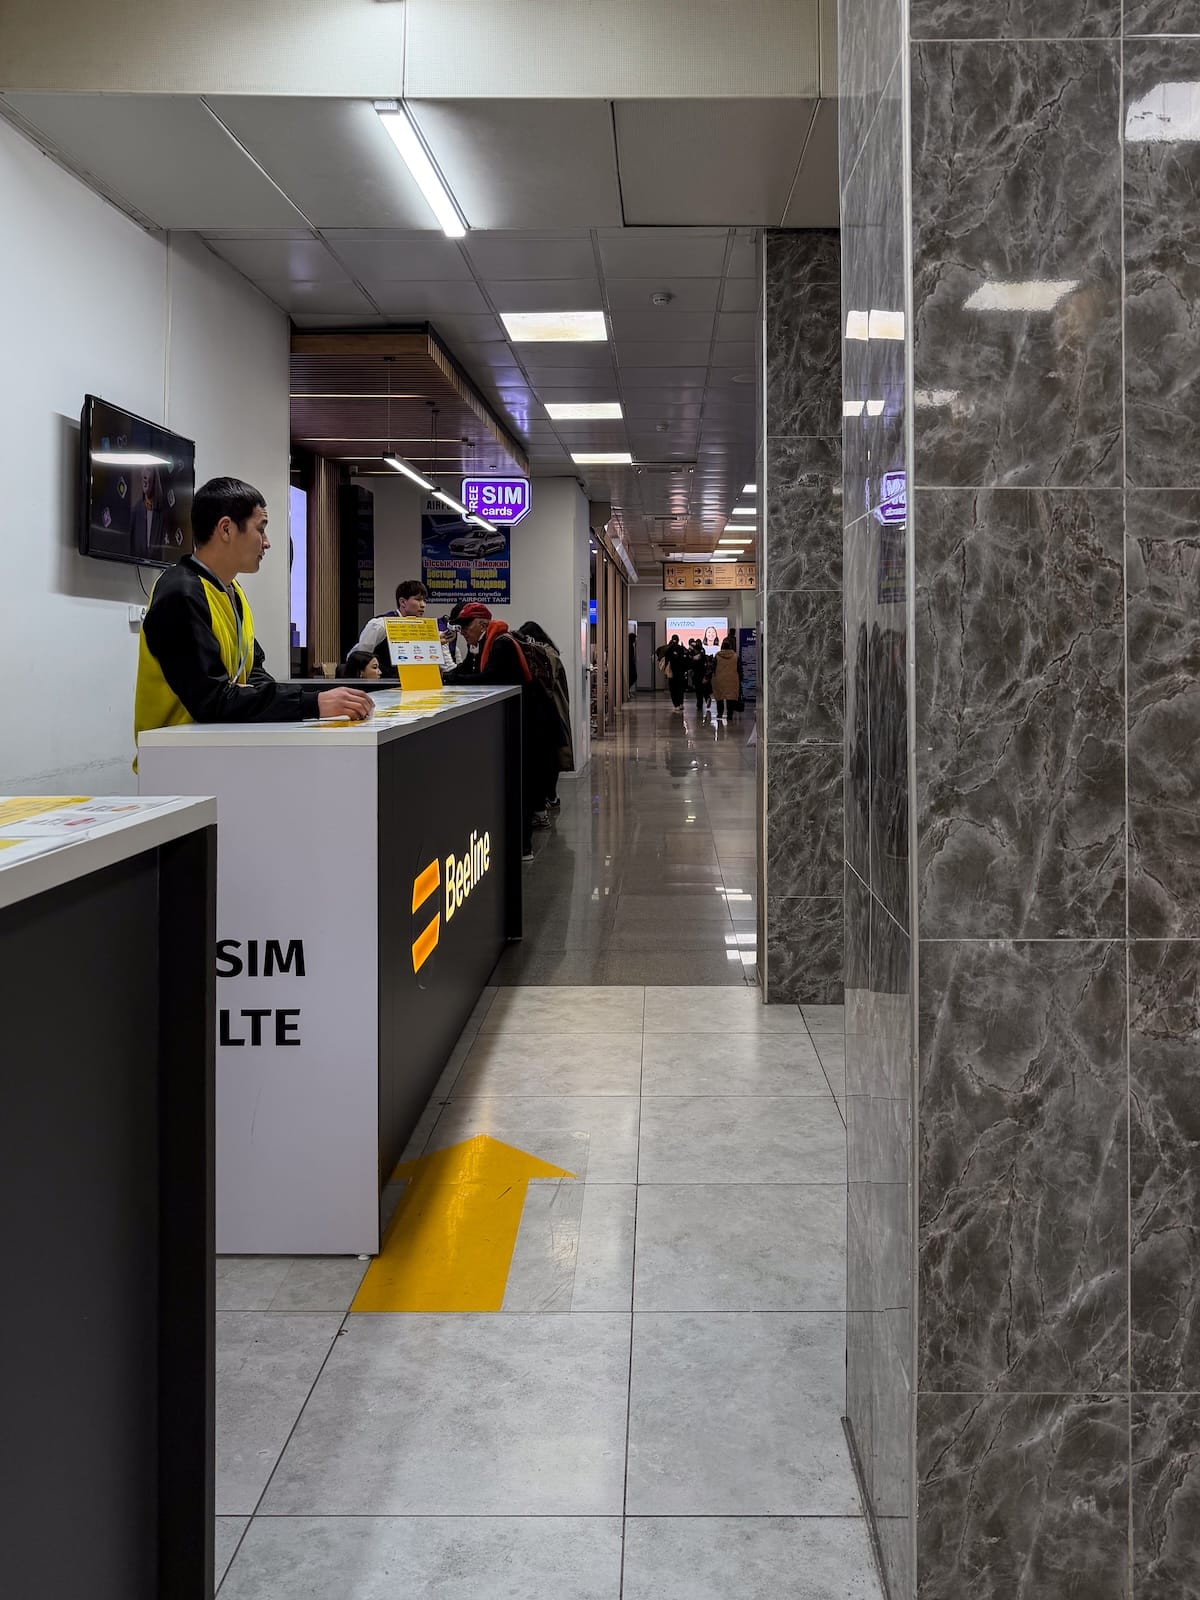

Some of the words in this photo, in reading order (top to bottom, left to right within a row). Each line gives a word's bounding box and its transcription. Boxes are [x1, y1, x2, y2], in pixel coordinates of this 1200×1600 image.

[482, 486, 521, 505] SIM
[482, 506, 513, 516] cards
[445, 830, 490, 923] Beeline
[216, 939, 306, 978] SIM
[219, 1009, 301, 1046] LTE
